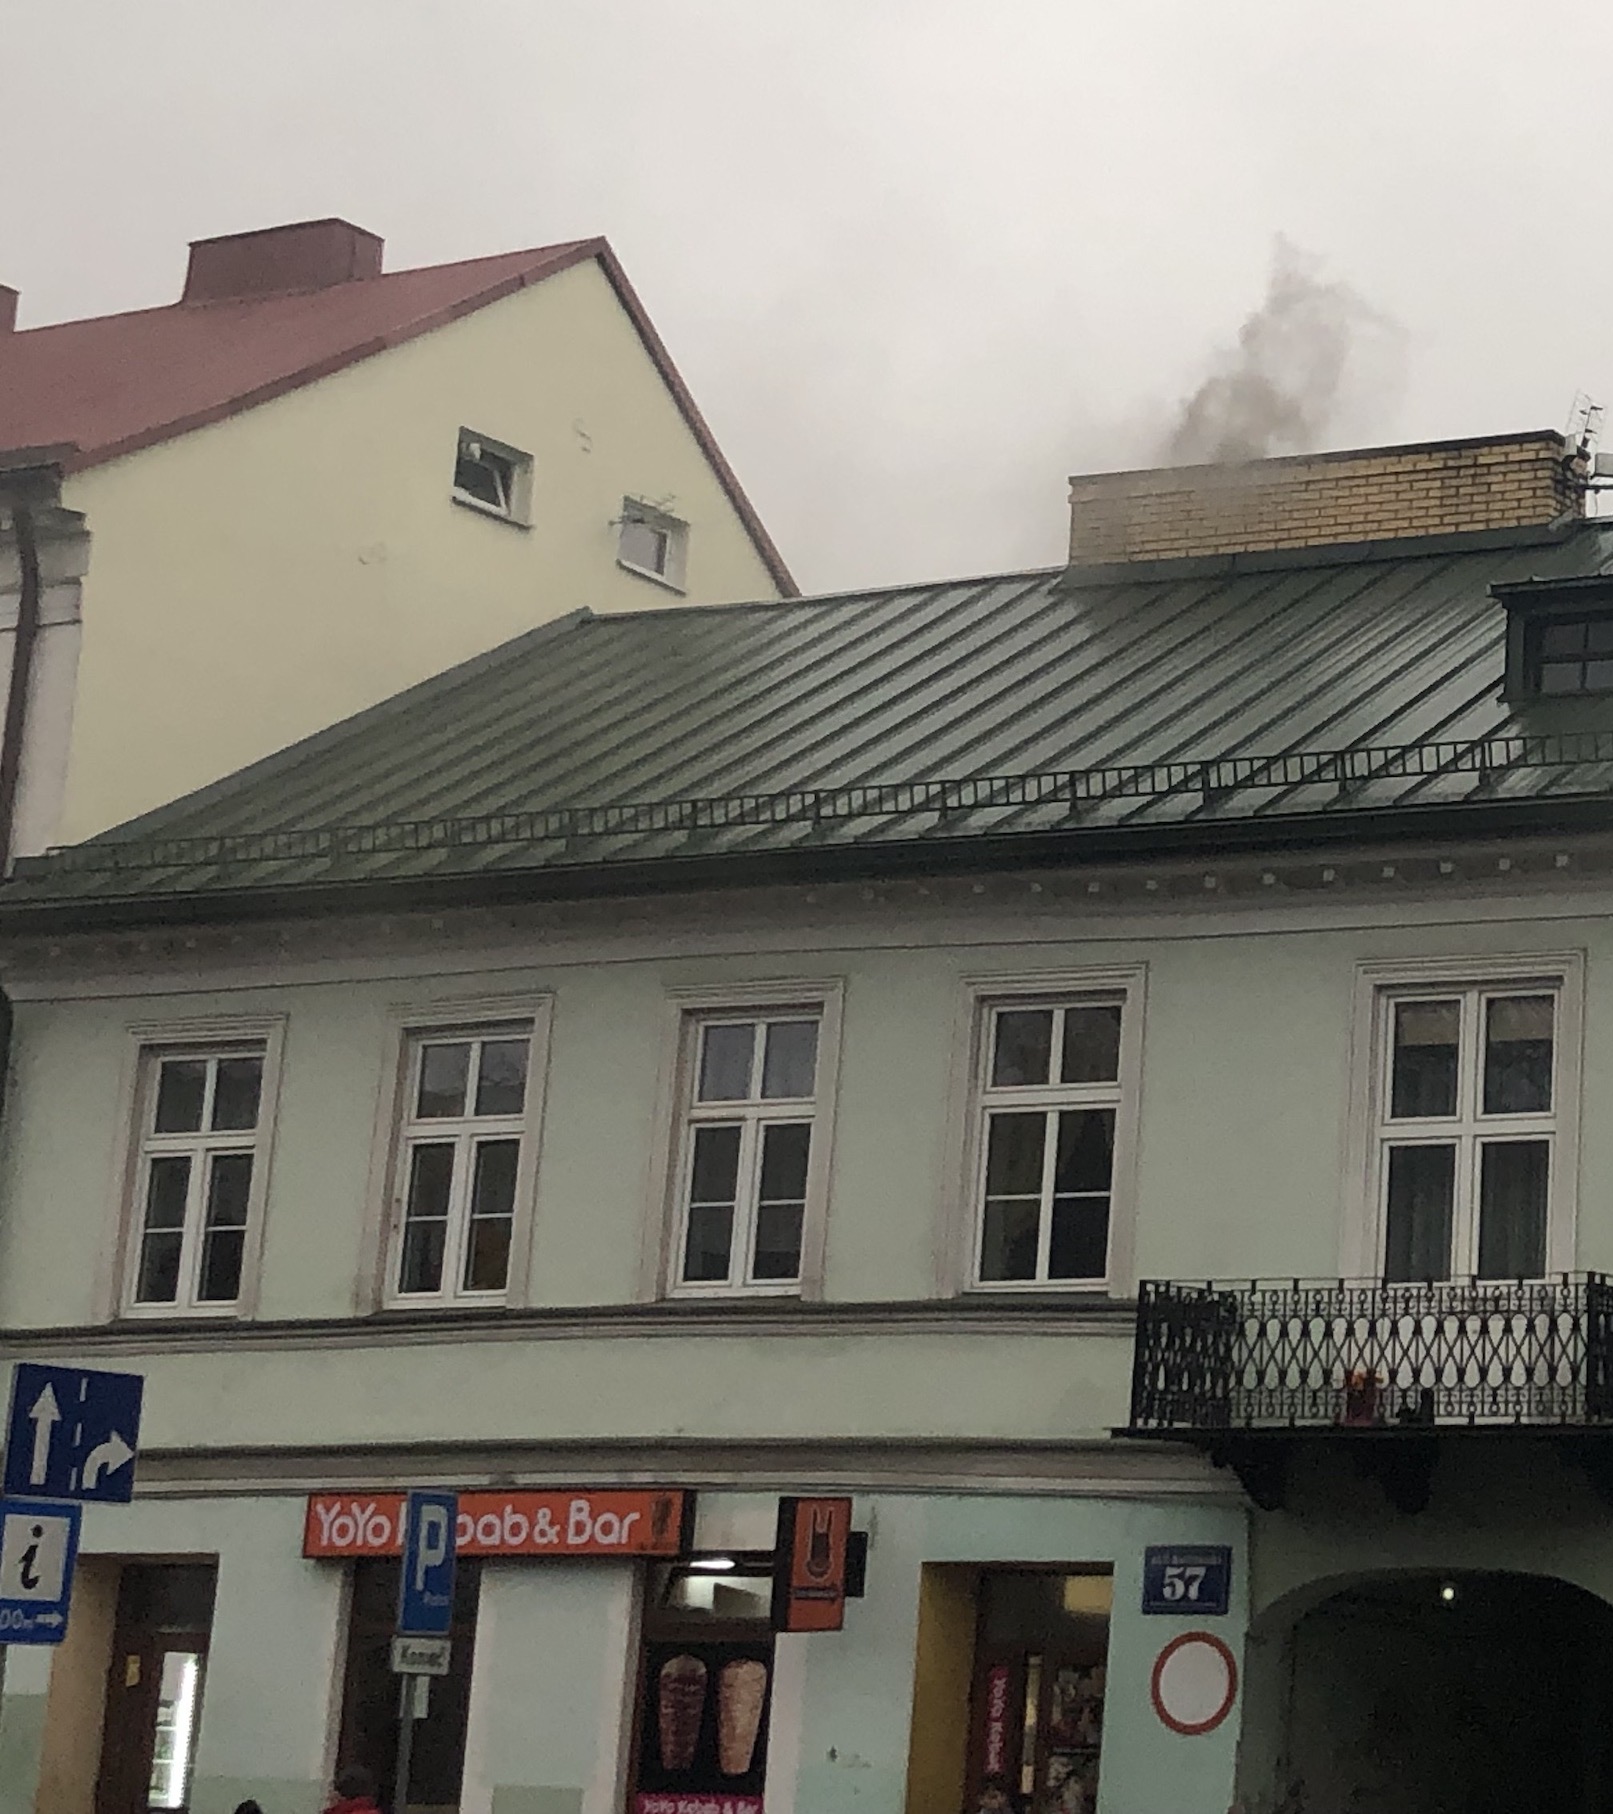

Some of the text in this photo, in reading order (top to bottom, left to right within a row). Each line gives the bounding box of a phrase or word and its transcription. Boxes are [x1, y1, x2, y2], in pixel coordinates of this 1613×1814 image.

[315, 1501, 392, 1547] YoYo
[533, 1507, 561, 1545] &
[566, 1499, 641, 1545] Bar
[415, 1504, 450, 1591] P
[1162, 1565, 1207, 1601] 57
